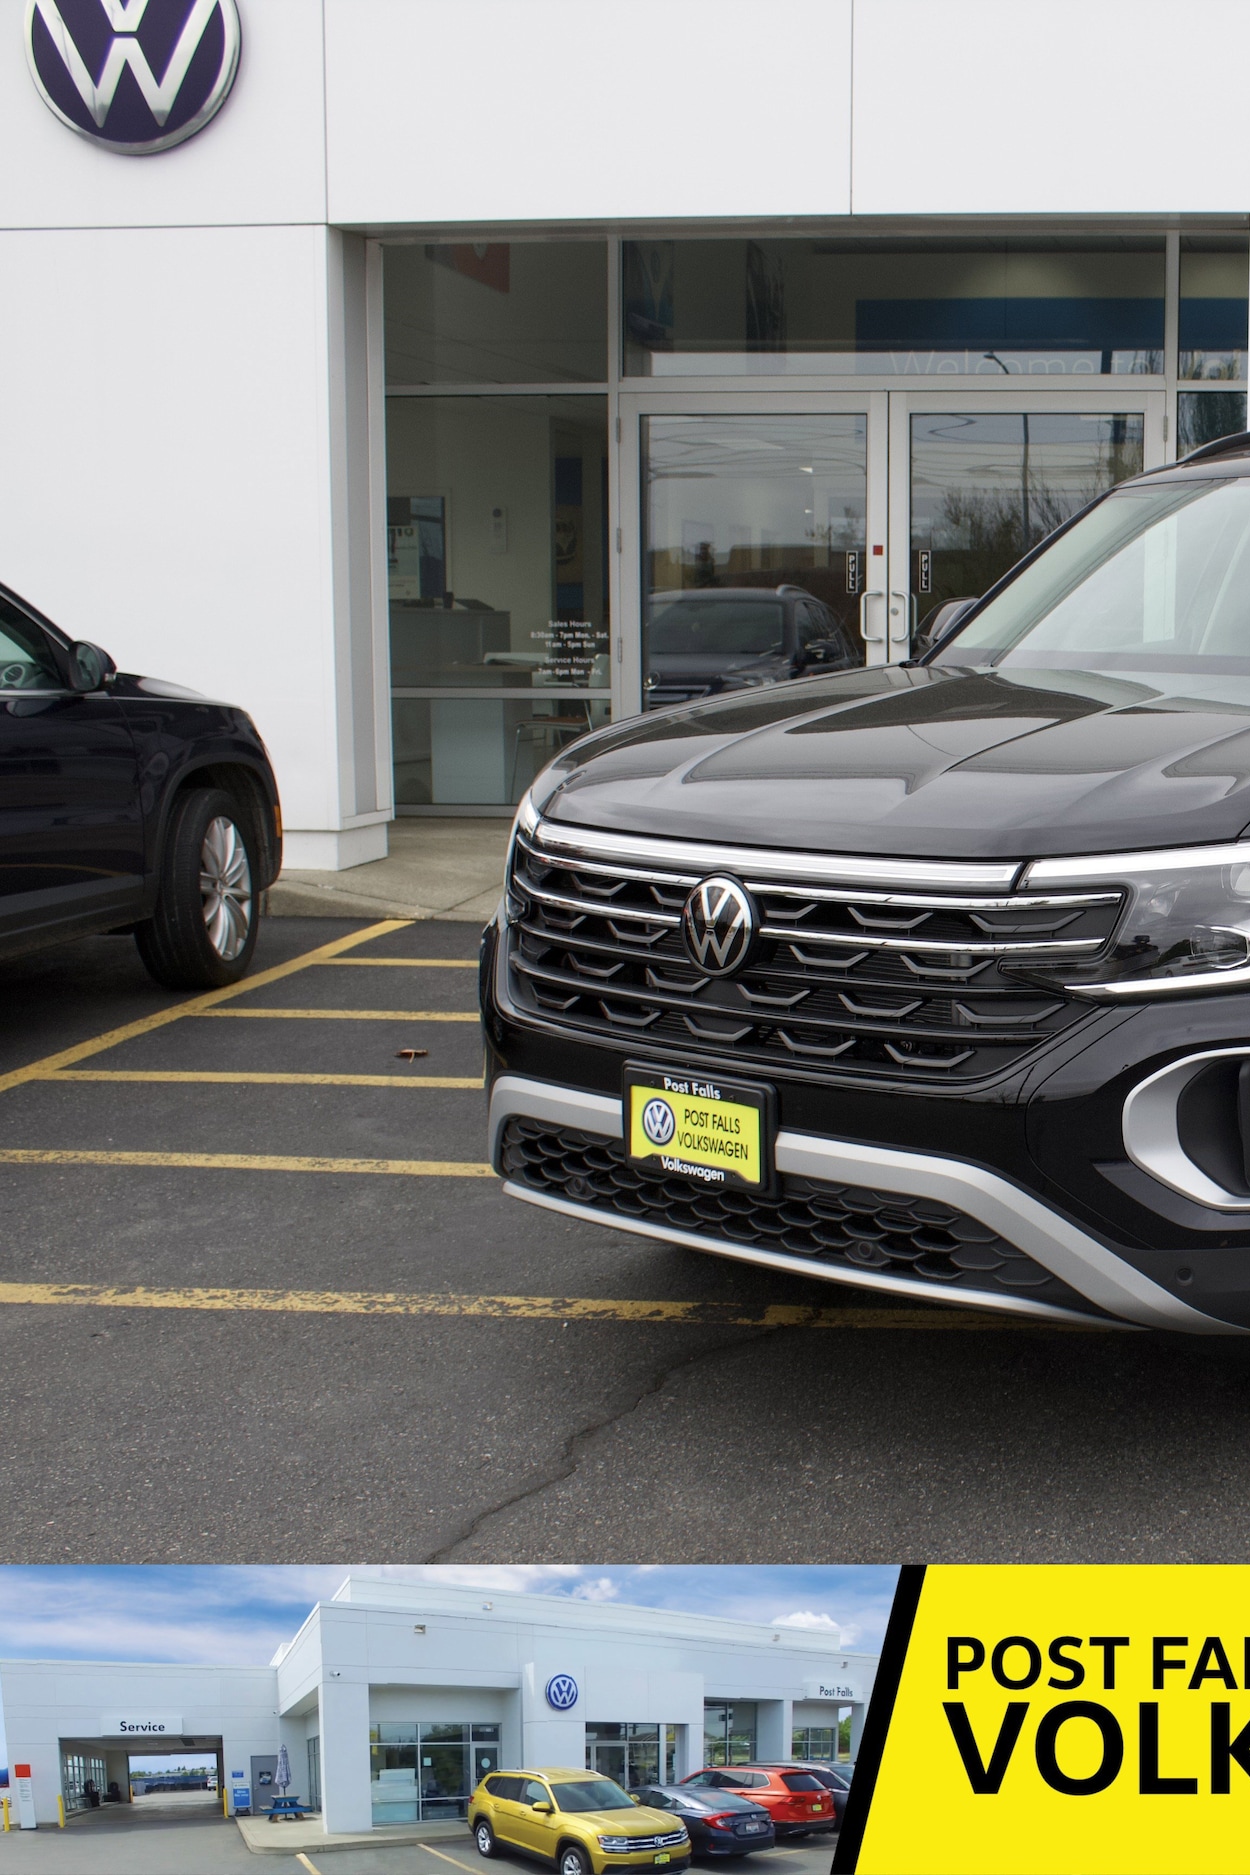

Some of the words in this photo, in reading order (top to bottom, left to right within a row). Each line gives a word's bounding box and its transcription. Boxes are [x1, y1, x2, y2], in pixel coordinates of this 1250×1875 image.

[921, 554, 929, 589] PULL
[664, 1077, 690, 1094] Post
[692, 1082, 721, 1100] Falls
[684, 1109, 709, 1129] POST
[712, 1114, 741, 1134] FALLS
[677, 1130, 748, 1160] VOLKSWAGEN
[661, 1156, 725, 1181] Volkswagen
